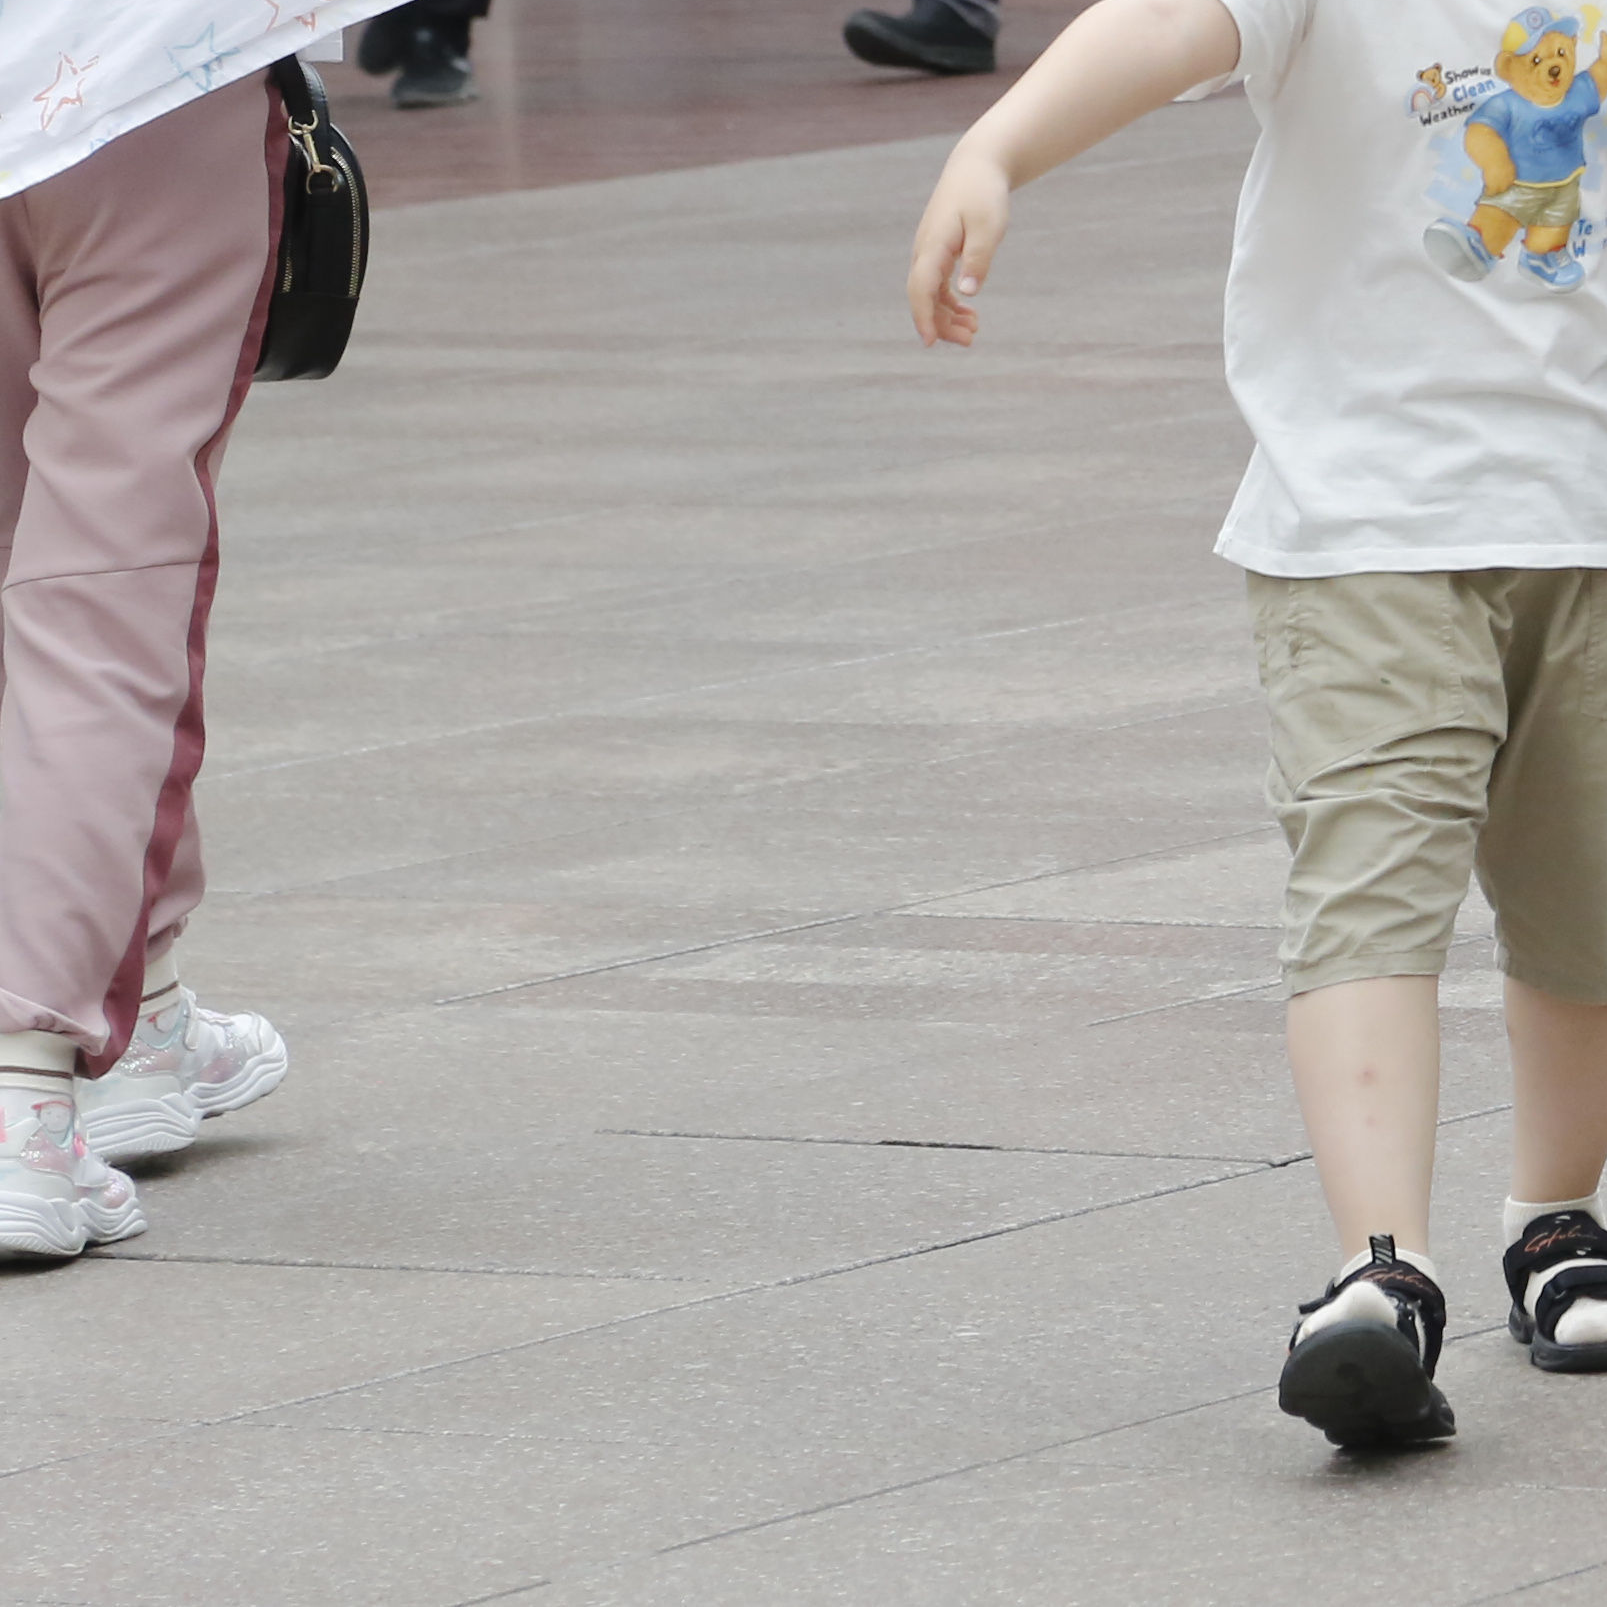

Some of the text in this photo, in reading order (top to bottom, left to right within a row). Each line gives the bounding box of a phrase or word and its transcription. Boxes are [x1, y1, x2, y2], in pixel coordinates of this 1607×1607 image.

[1445, 65, 1479, 85] Show
[1453, 79, 1496, 102] Clean
[1419, 102, 1476, 127] Weather
